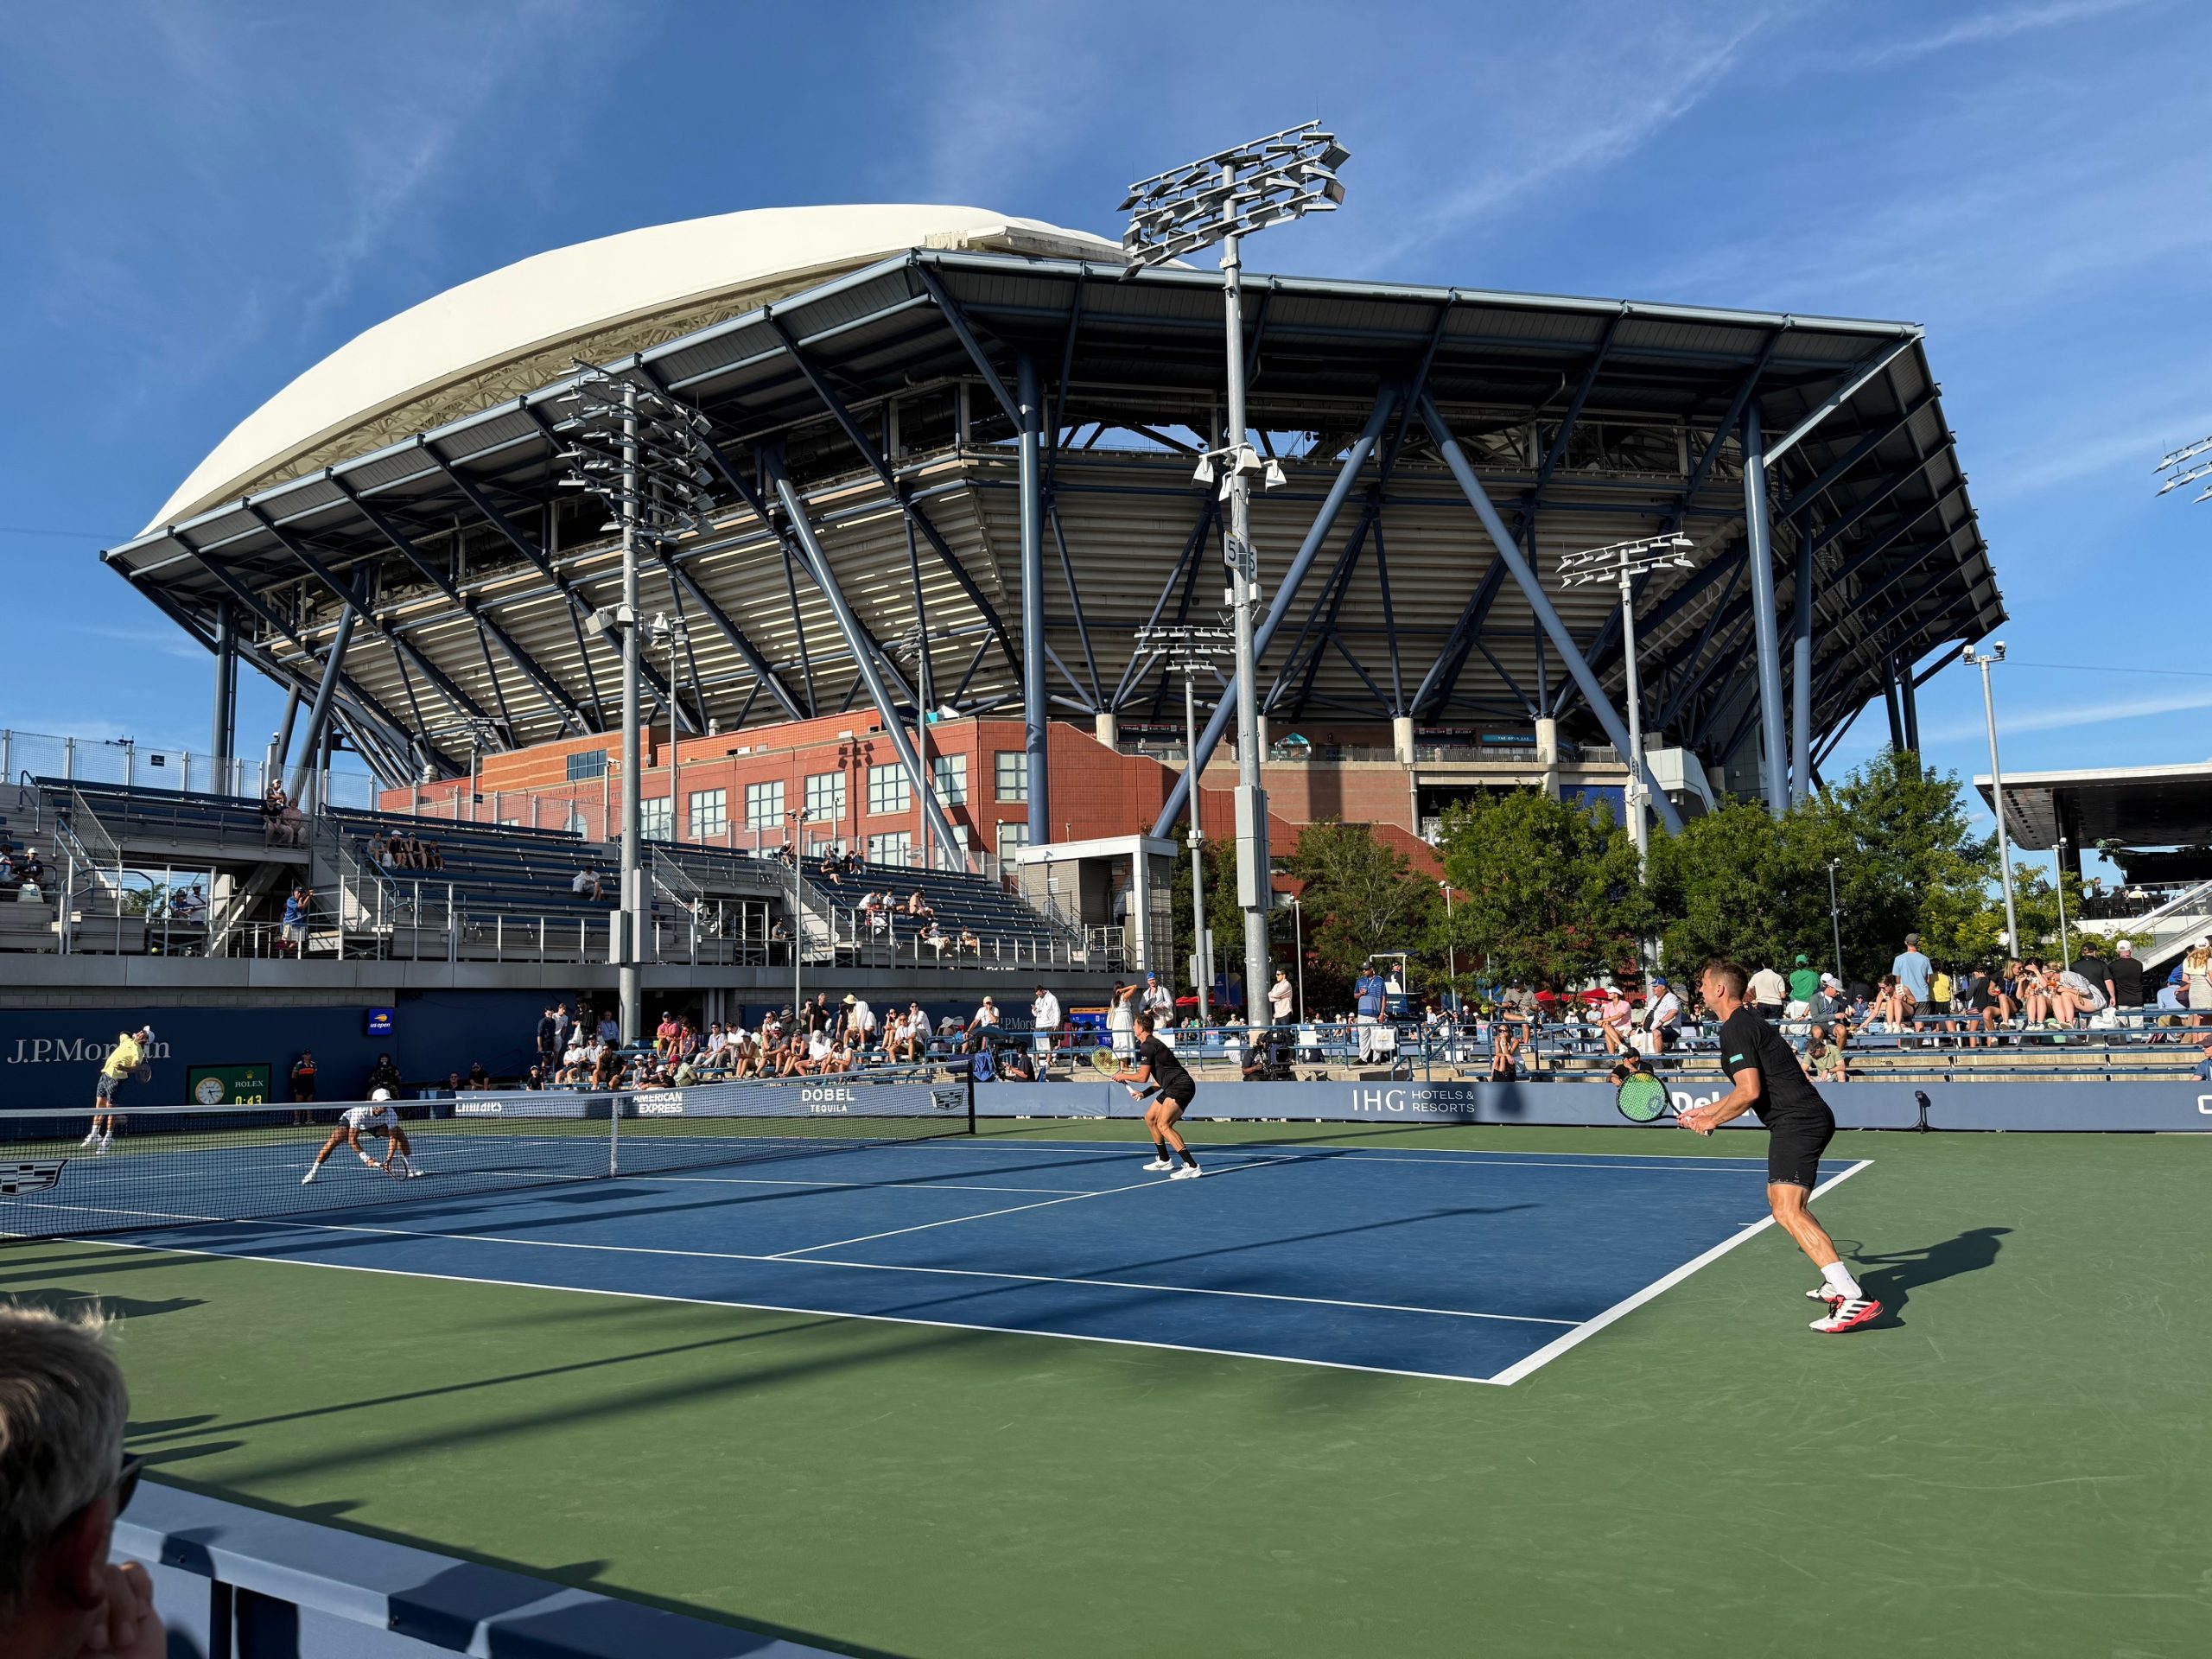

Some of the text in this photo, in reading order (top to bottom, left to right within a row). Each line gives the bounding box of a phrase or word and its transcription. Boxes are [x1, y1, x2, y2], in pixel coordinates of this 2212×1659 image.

[1228, 539, 1236, 562] 5
[7, 1037, 171, 1064] J.P.Morn
[632, 1091, 683, 1103] AMERICAN
[802, 1089, 855, 1101] DOBEL
[1352, 1089, 1404, 1112] IHG
[1411, 1090, 1474, 1100] HOTELS &
[639, 1103, 683, 1113] EXPRESS
[1412, 1103, 1475, 1113] RESORTS
